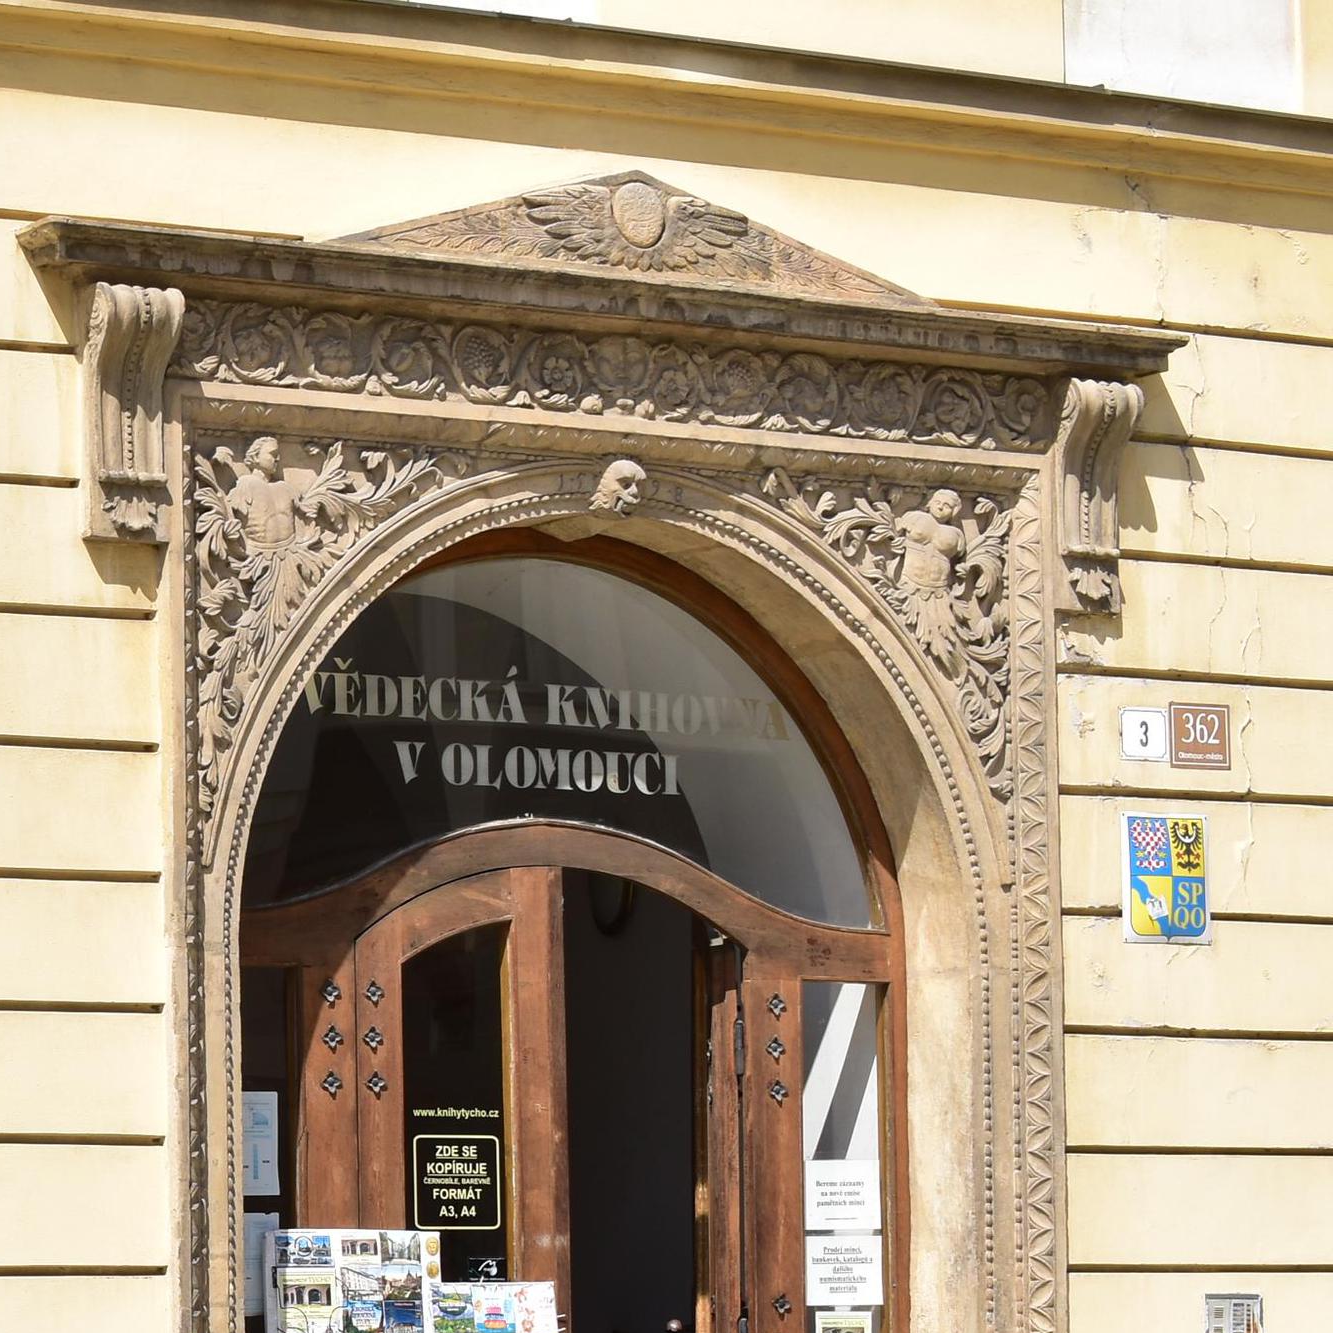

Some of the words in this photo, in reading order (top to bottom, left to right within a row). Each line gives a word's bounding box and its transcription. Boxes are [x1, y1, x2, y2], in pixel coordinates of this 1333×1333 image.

[303, 657, 528, 725] VĚDECKÁ
[545, 683, 791, 741] KNIHOVNA
[1140, 720, 1148, 747] 3
[1181, 713, 1220, 744] 362
[393, 741, 427, 785] V
[441, 742, 681, 795] OLOMOUCI
[1177, 882, 1203, 905] SP
[1174, 907, 1205, 929] QO
[413, 1106, 500, 1119] www.knihytycho.cz
[435, 1145, 459, 1157] ZDE
[461, 1145, 477, 1157] SE
[426, 1159, 487, 1175] KOPÍRUJE
[433, 1185, 482, 1200] FORMÁT
[439, 1205, 458, 1219] A3,
[460, 1205, 477, 1217] A4
